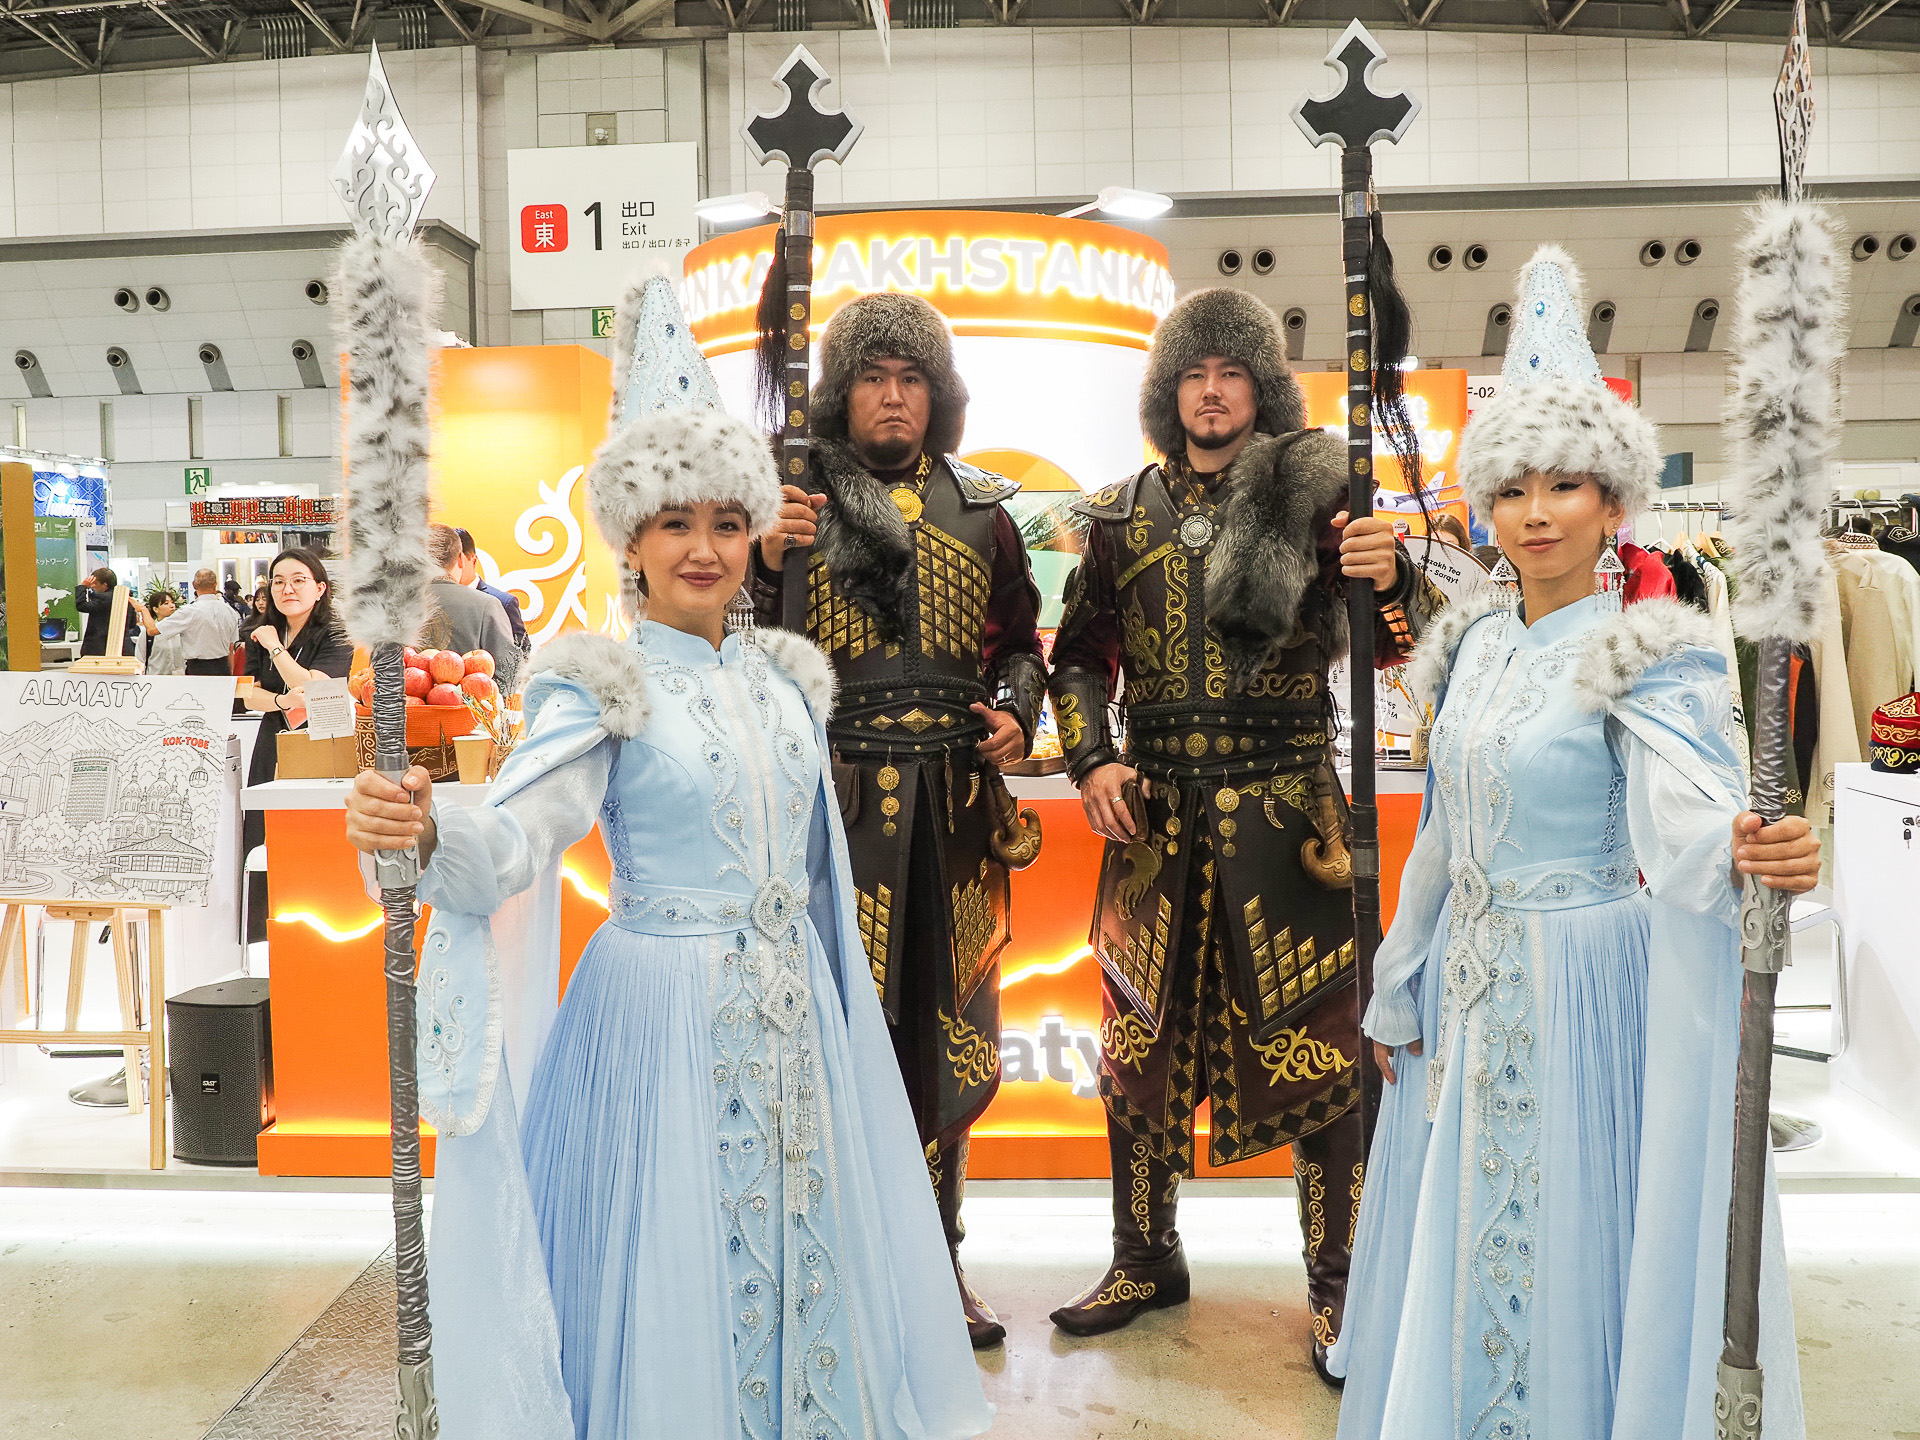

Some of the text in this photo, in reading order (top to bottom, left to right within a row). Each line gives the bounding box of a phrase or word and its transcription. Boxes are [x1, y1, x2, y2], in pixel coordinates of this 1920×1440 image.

[535, 210, 554, 220] East
[622, 201, 654, 217] 出口
[534, 222, 555, 248] 東
[584, 202, 602, 250] 1
[622, 222, 647, 235] Exit
[1420, 554, 1461, 577] Kzakh Tea
[20, 679, 152, 708] ALMATY
[162, 736, 210, 749] KOK-TOBE
